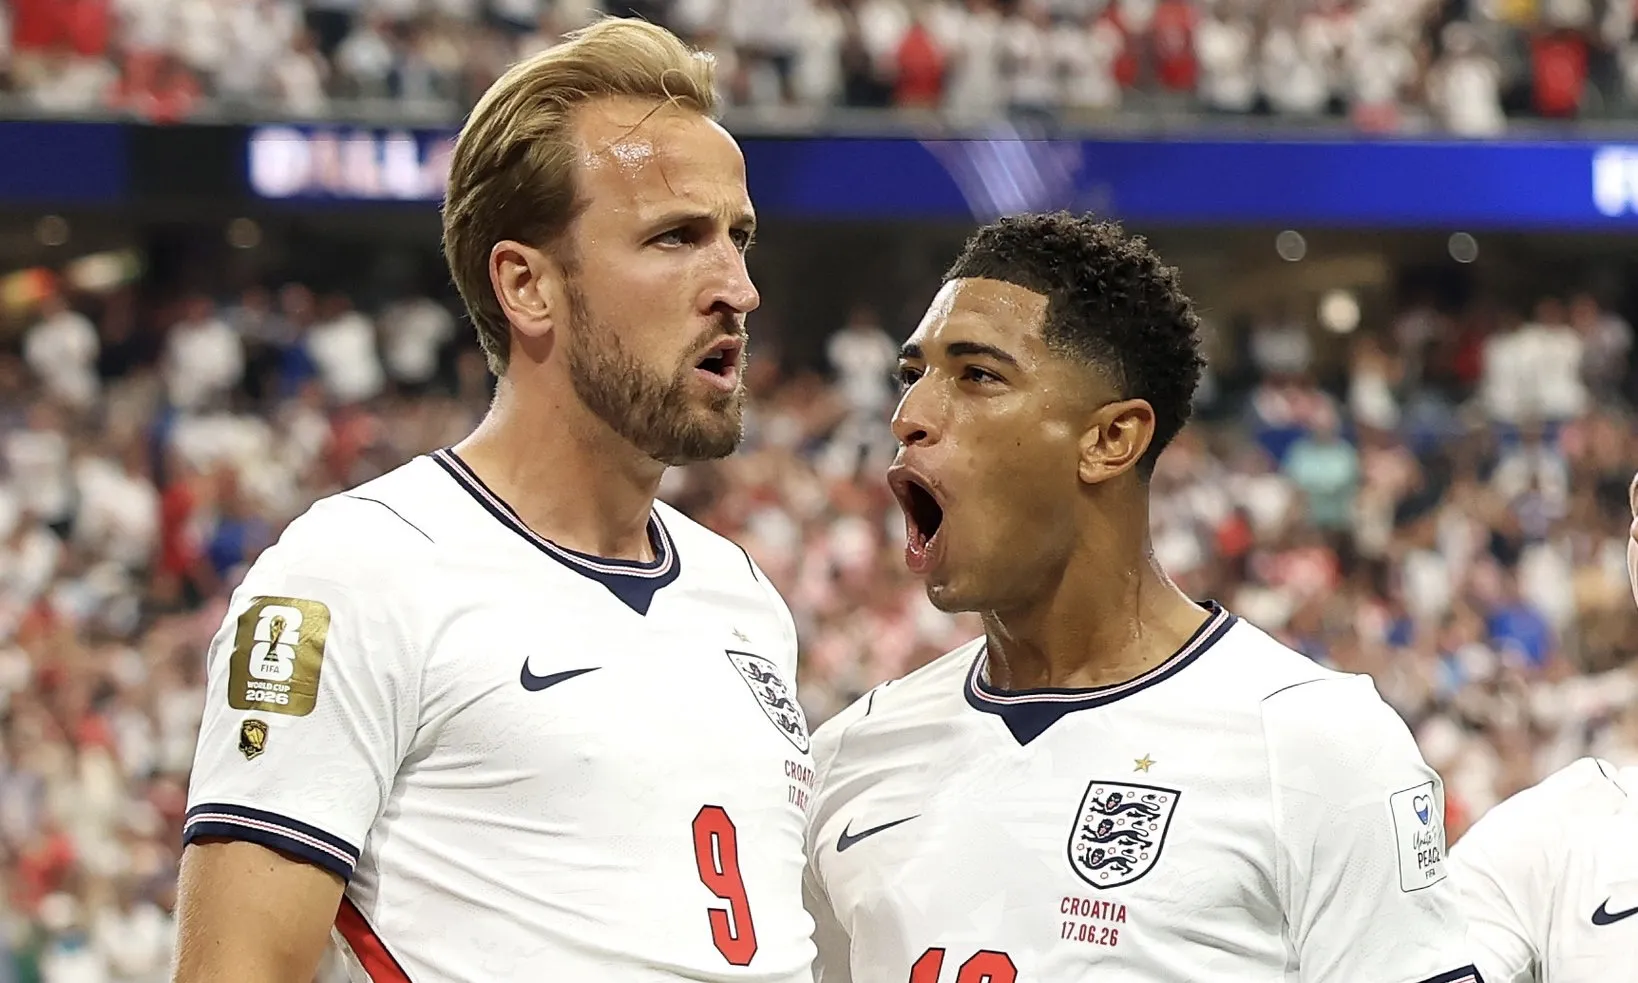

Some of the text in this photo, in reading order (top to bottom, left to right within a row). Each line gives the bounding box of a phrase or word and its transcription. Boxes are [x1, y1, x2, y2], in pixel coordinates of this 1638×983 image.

[260, 664, 280, 673] FIFA
[247, 681, 291, 692] WORLD CUP
[245, 690, 289, 705] 2026
[692, 804, 758, 966] 9
[1060, 896, 1126, 924] CROATIA
[1061, 921, 1119, 947] 17.06.26
